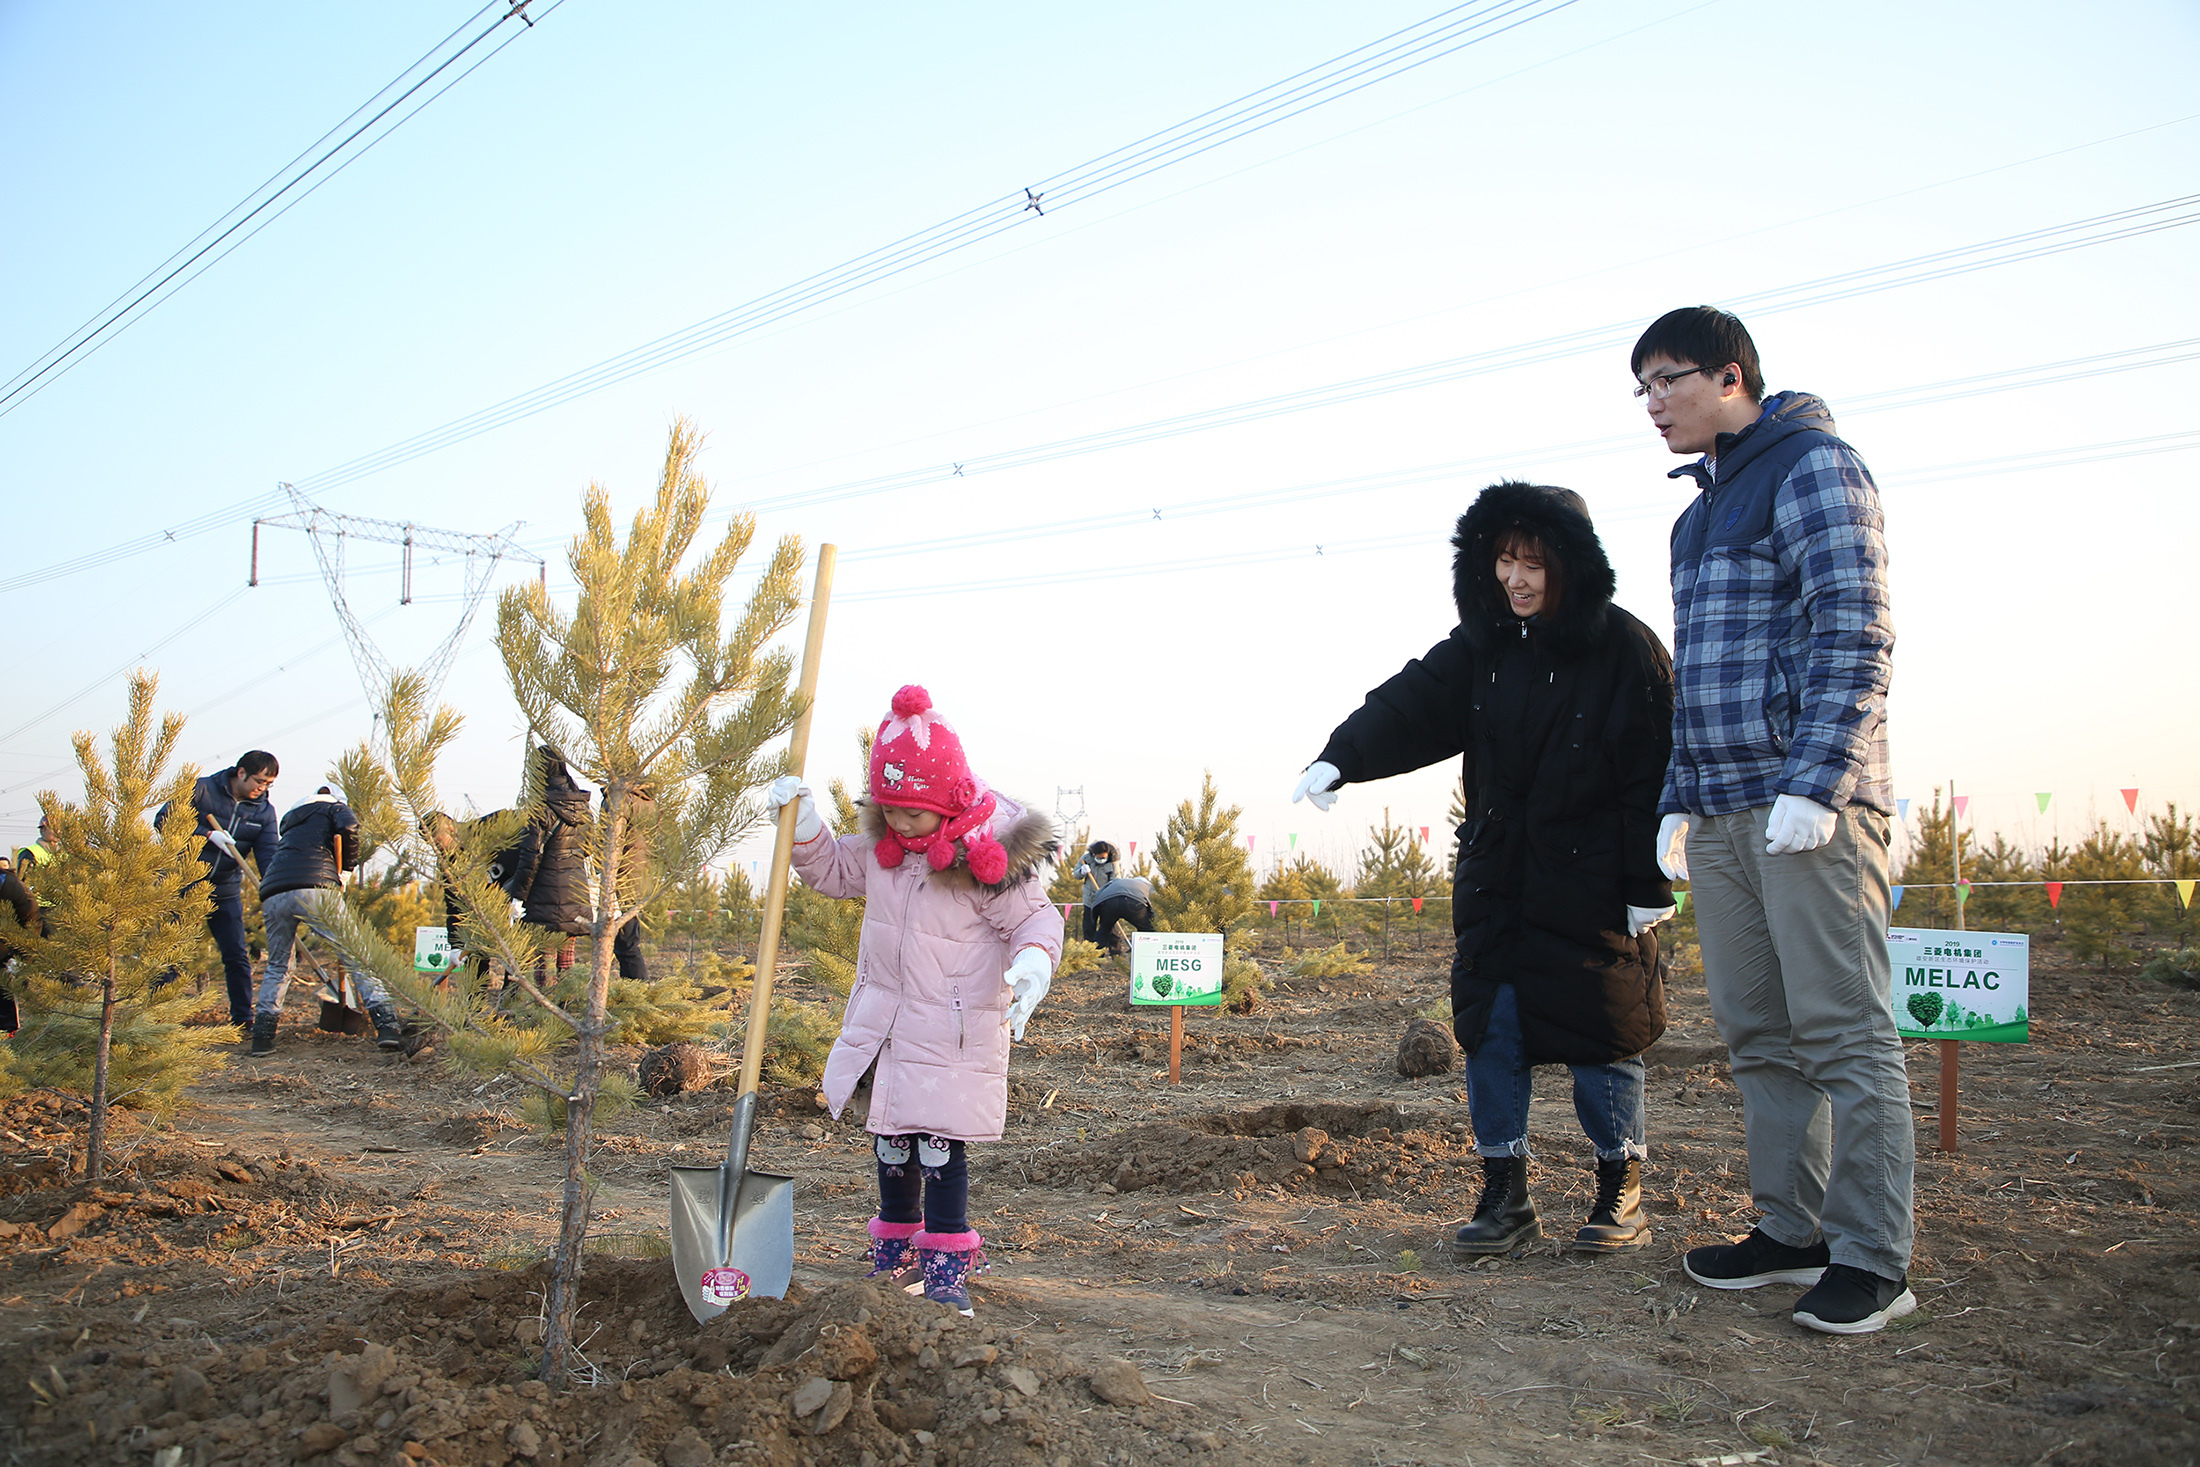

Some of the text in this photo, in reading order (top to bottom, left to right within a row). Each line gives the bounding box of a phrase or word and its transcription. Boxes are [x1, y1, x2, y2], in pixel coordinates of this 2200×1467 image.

[1944, 940, 1960, 948] 2019
[1923, 946, 1982, 959] 三菱电机集团
[1156, 958, 1202, 972] MESG
[1905, 967, 2000, 991] MELAC
